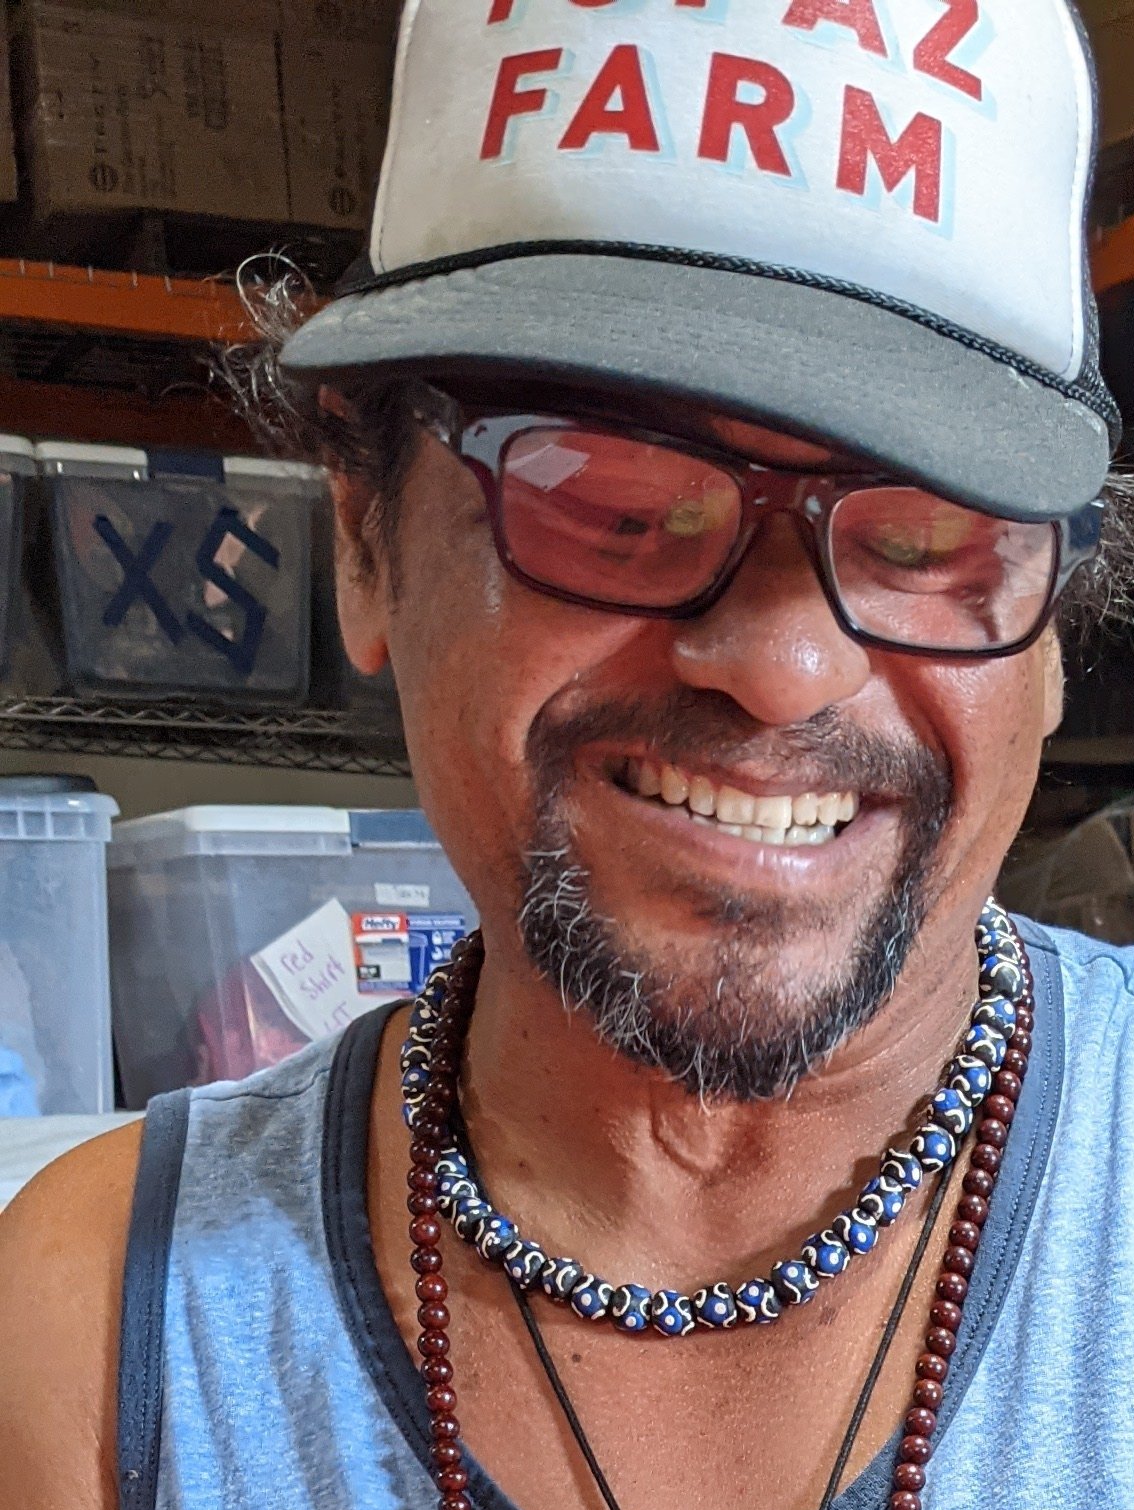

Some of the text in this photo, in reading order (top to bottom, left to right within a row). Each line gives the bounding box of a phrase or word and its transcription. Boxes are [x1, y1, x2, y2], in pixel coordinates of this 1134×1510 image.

[480, 44, 942, 223] FARM
[92, 507, 281, 675] XS
[365, 919, 399, 931] Hefty
